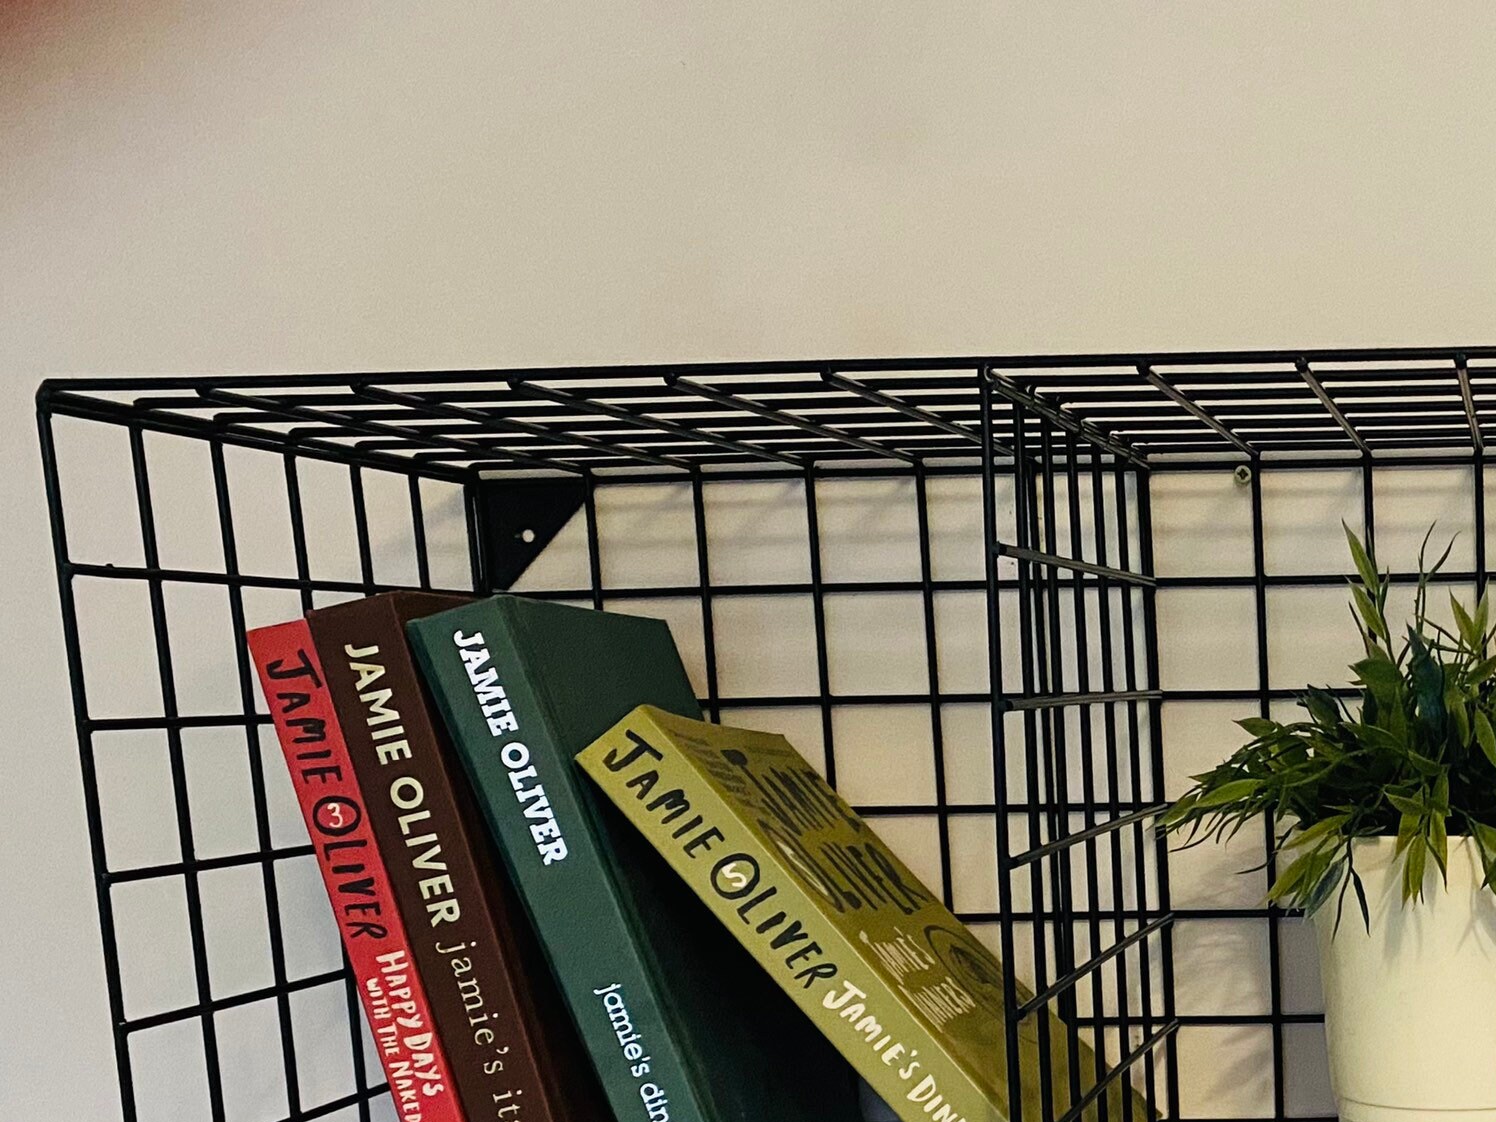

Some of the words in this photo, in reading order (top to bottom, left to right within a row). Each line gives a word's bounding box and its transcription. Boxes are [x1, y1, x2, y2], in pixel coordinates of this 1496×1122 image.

[266, 648, 343, 785] JAMIE
[312, 795, 388, 939] OLIVER
[453, 629, 519, 737] JAMIE
[501, 741, 569, 866] OLIVER
[344, 644, 412, 765] JAMIE
[390, 776, 461, 928] OLIVER
[435, 941, 509, 1075] jamie's
[603, 729, 726, 859] JAMIE
[710, 853, 838, 990] OLIVER
[822, 980, 921, 1080] JAMIE'S
[366, 977, 391, 1021] WITH
[375, 950, 424, 1029] HAPPY
[403, 1031, 444, 1098] DAYS
[376, 1020, 400, 1057] THE
[593, 983, 651, 1078] jamie's
